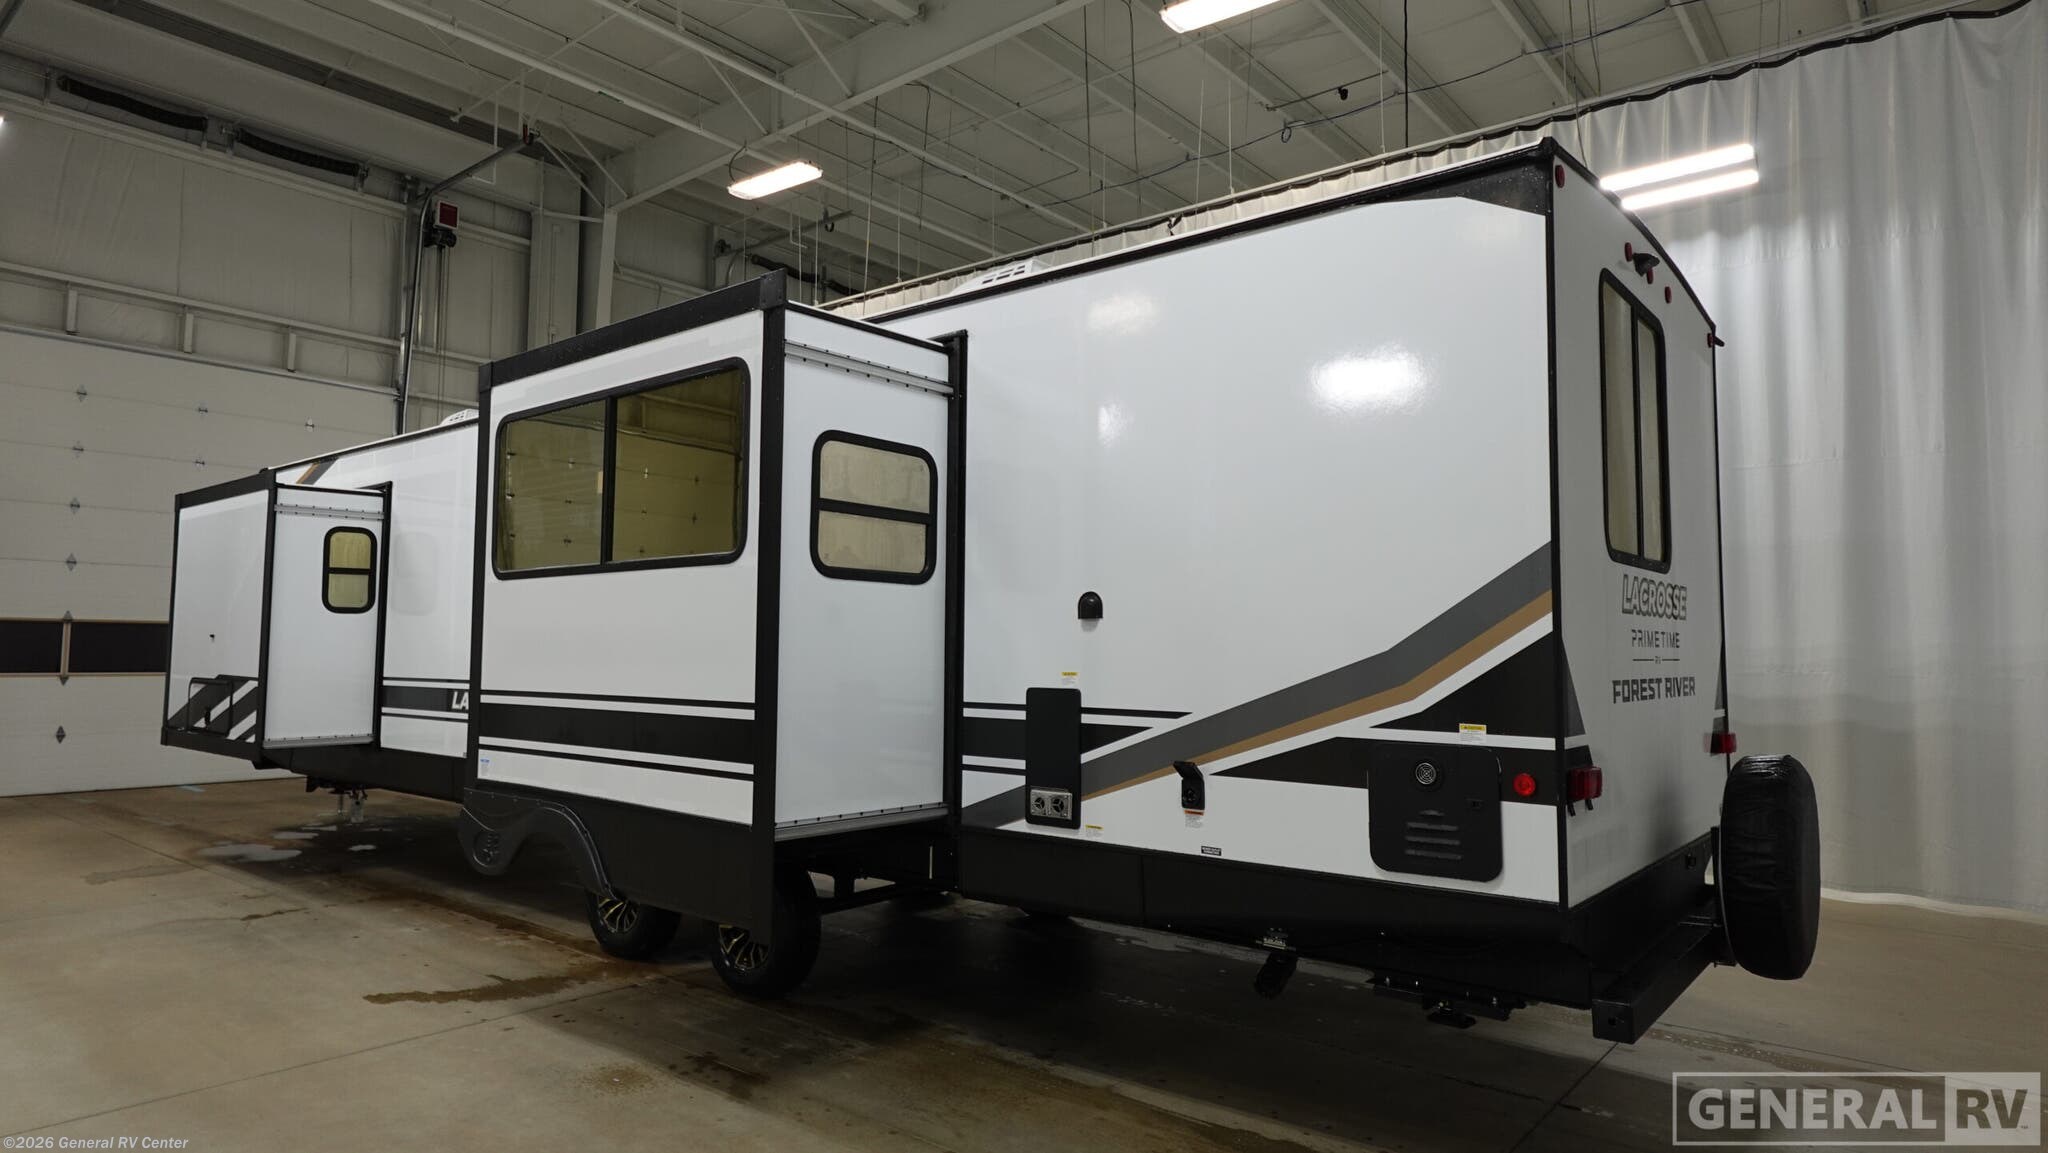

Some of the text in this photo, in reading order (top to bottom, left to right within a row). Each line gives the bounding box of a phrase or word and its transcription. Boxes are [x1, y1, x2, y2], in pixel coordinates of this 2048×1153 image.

[1622, 574, 1687, 621] LACROSSE
[1612, 676, 1696, 704] FOREST RIVER
